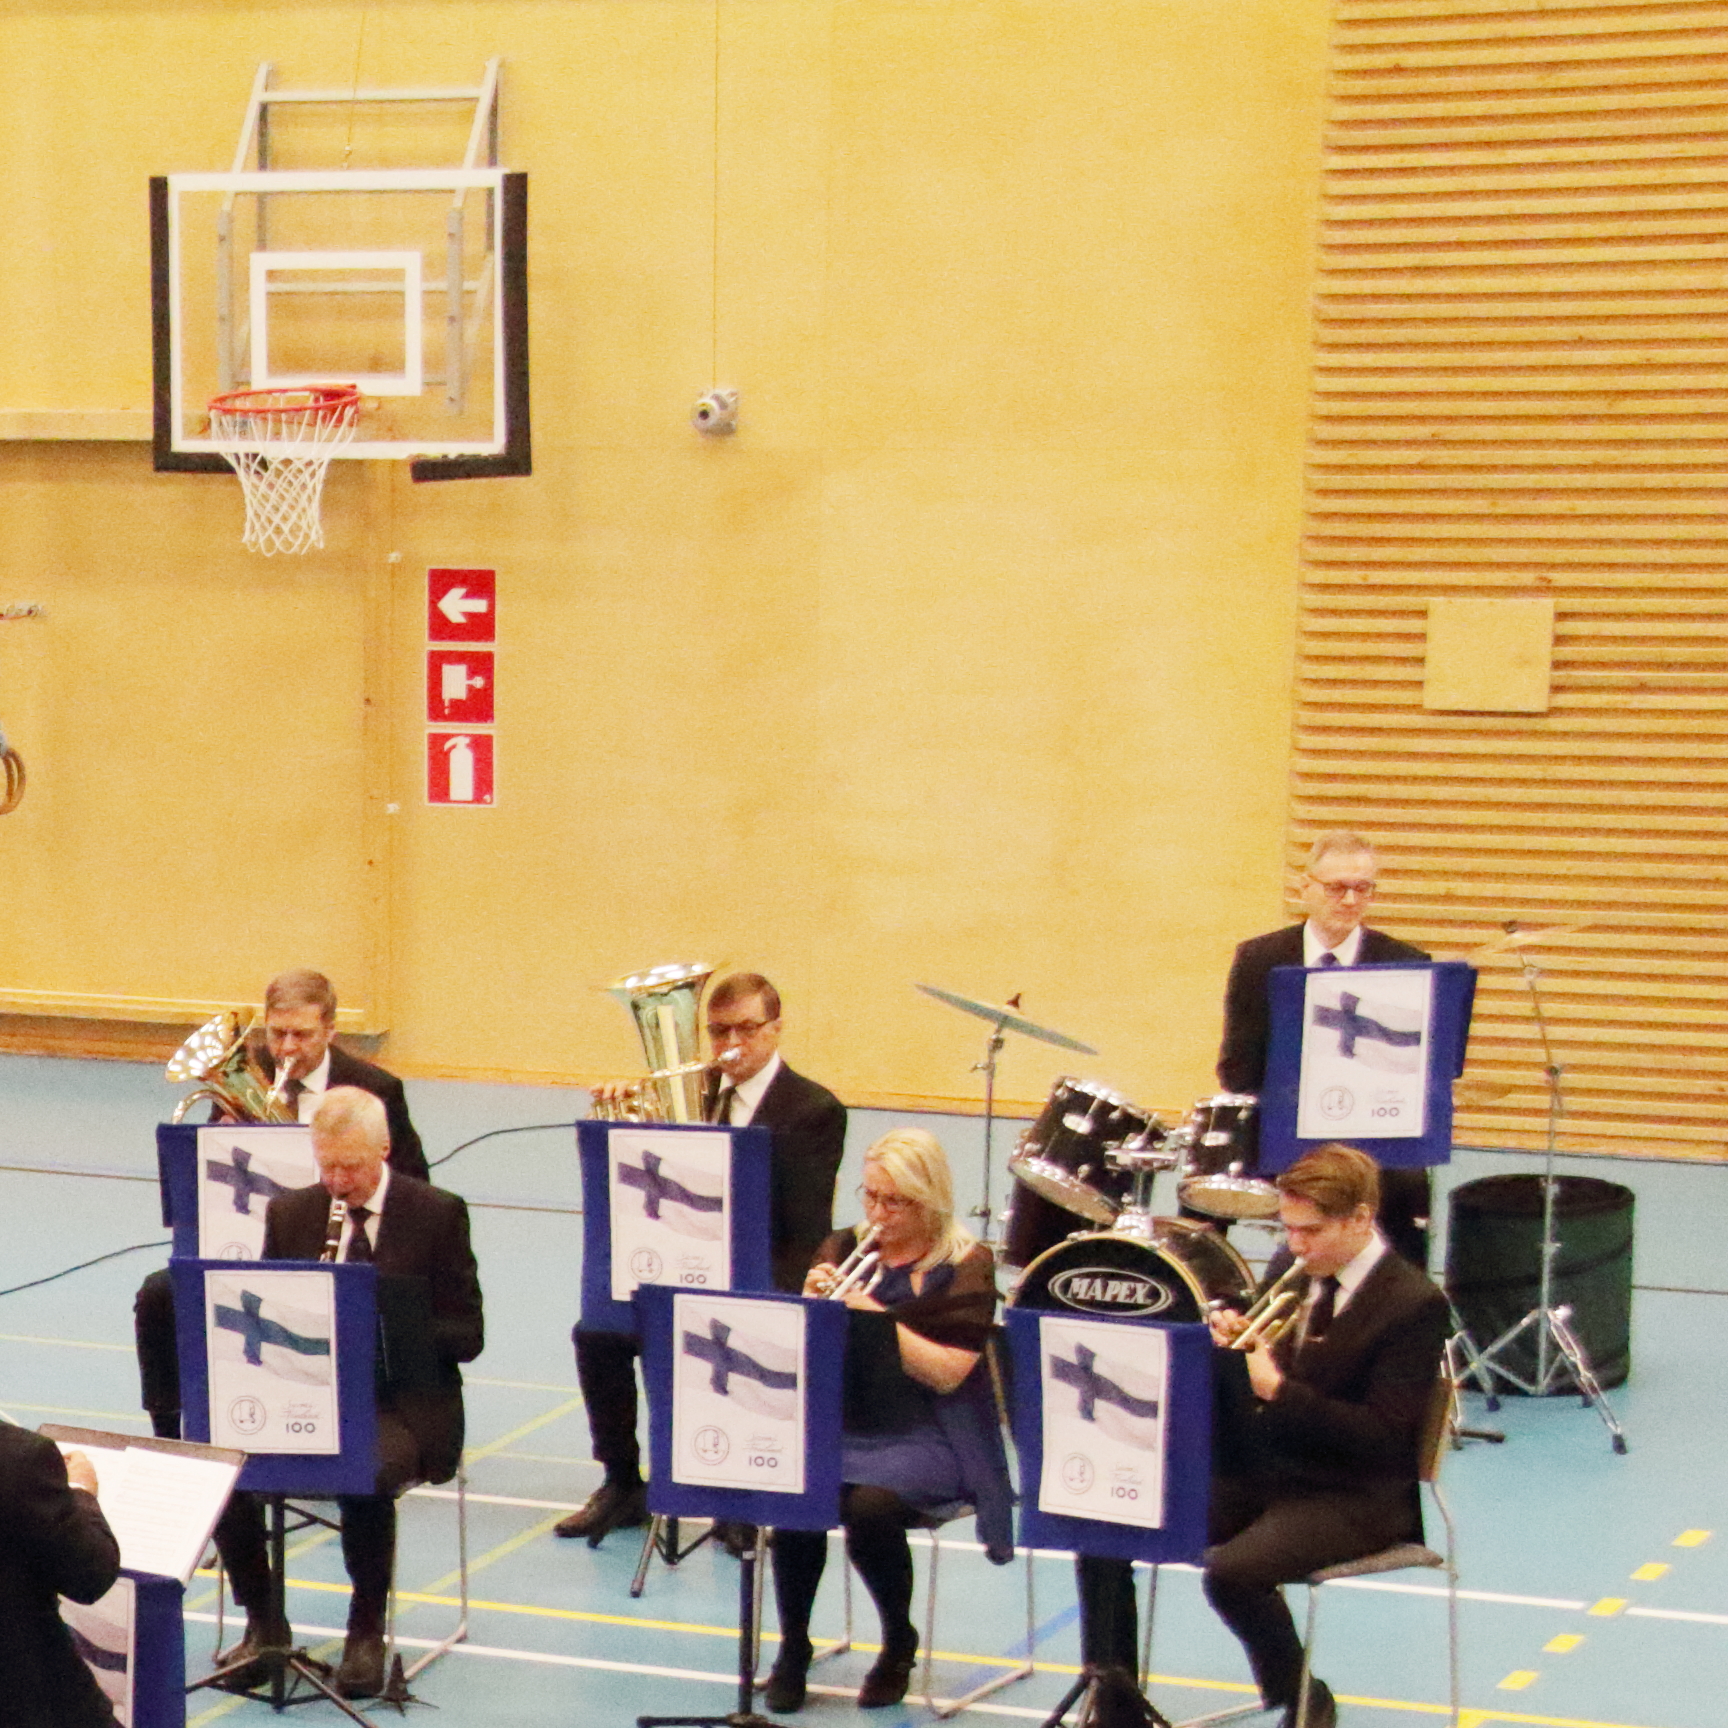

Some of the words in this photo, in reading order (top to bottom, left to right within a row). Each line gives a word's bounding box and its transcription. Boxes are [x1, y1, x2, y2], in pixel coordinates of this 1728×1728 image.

[1370, 1106, 1401, 1118] 100
[679, 1273, 707, 1285] 100
[1067, 1277, 1153, 1305] MAPEX
[285, 1421, 316, 1434] 100
[748, 1455, 778, 1469] 100
[1110, 1486, 1138, 1500] 100
